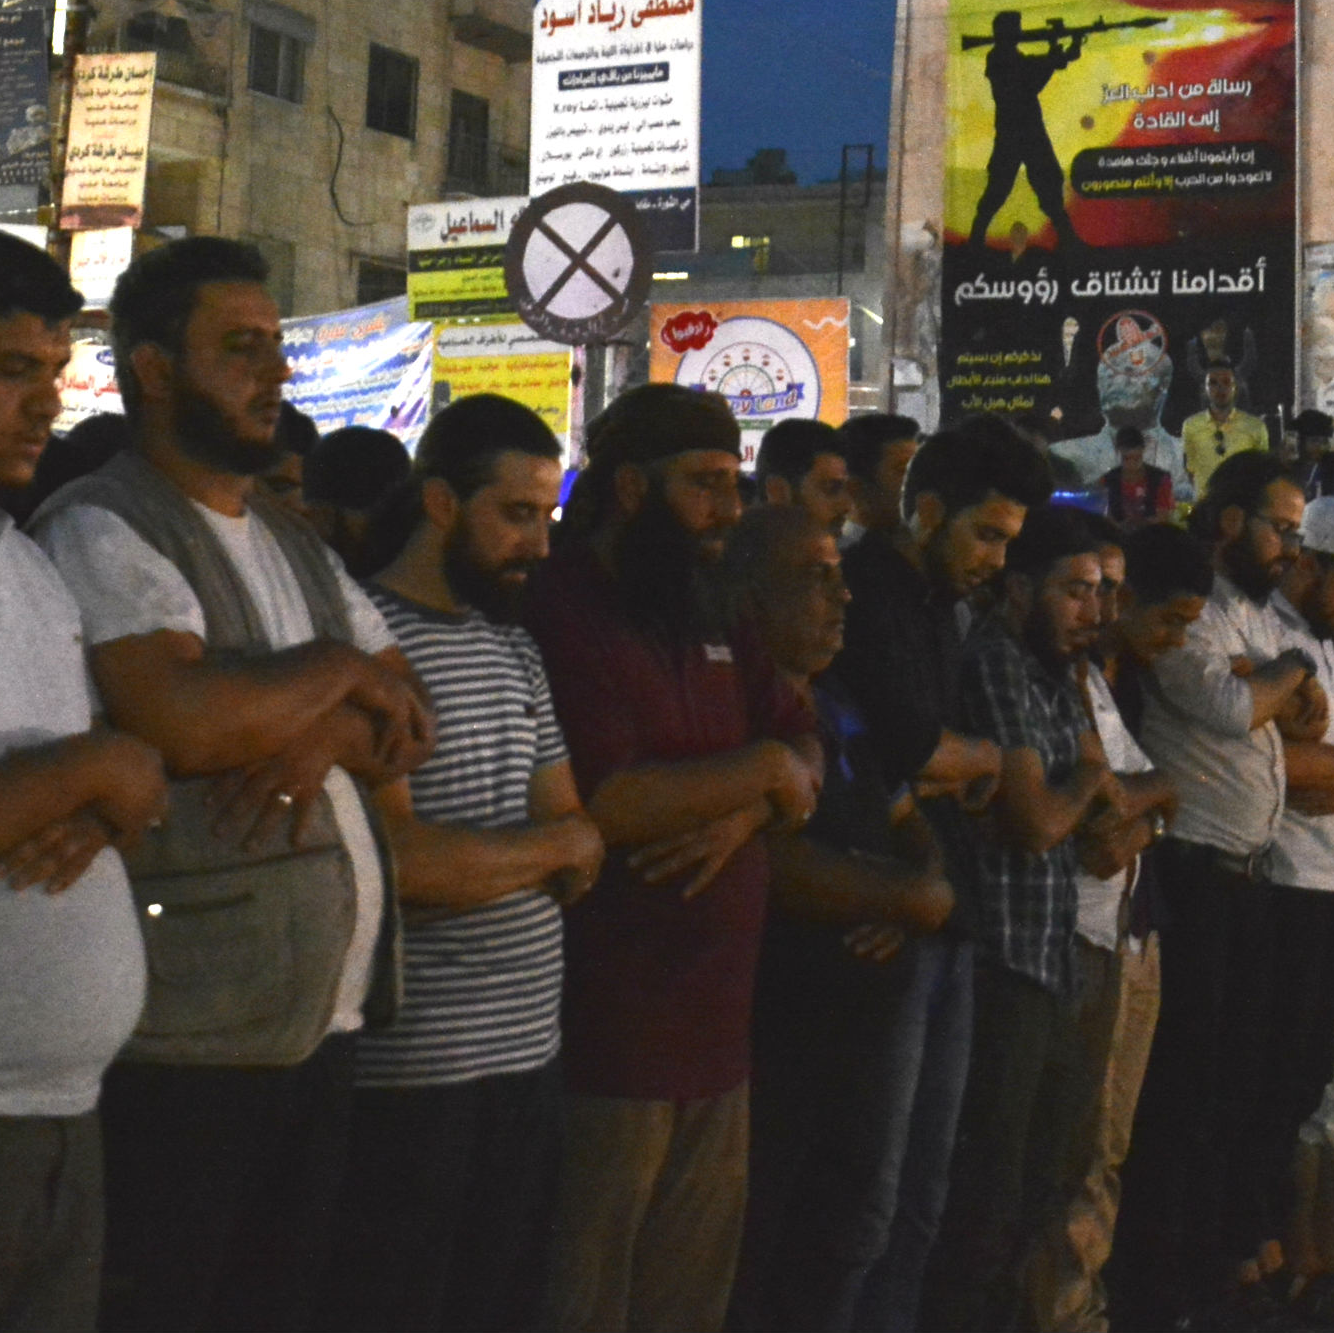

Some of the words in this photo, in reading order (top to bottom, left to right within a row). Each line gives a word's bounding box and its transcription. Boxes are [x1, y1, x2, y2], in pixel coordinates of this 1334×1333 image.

[1178, 84, 1204, 99] من
[1207, 78, 1252, 97] رسالة
[1134, 109, 1186, 129] القادة
[1188, 109, 1219, 132] إلى
[954, 267, 1059, 305] رؤوسكم
[1071, 267, 1161, 297] تشتاق
[1172, 256, 1266, 294] أقدامنا
